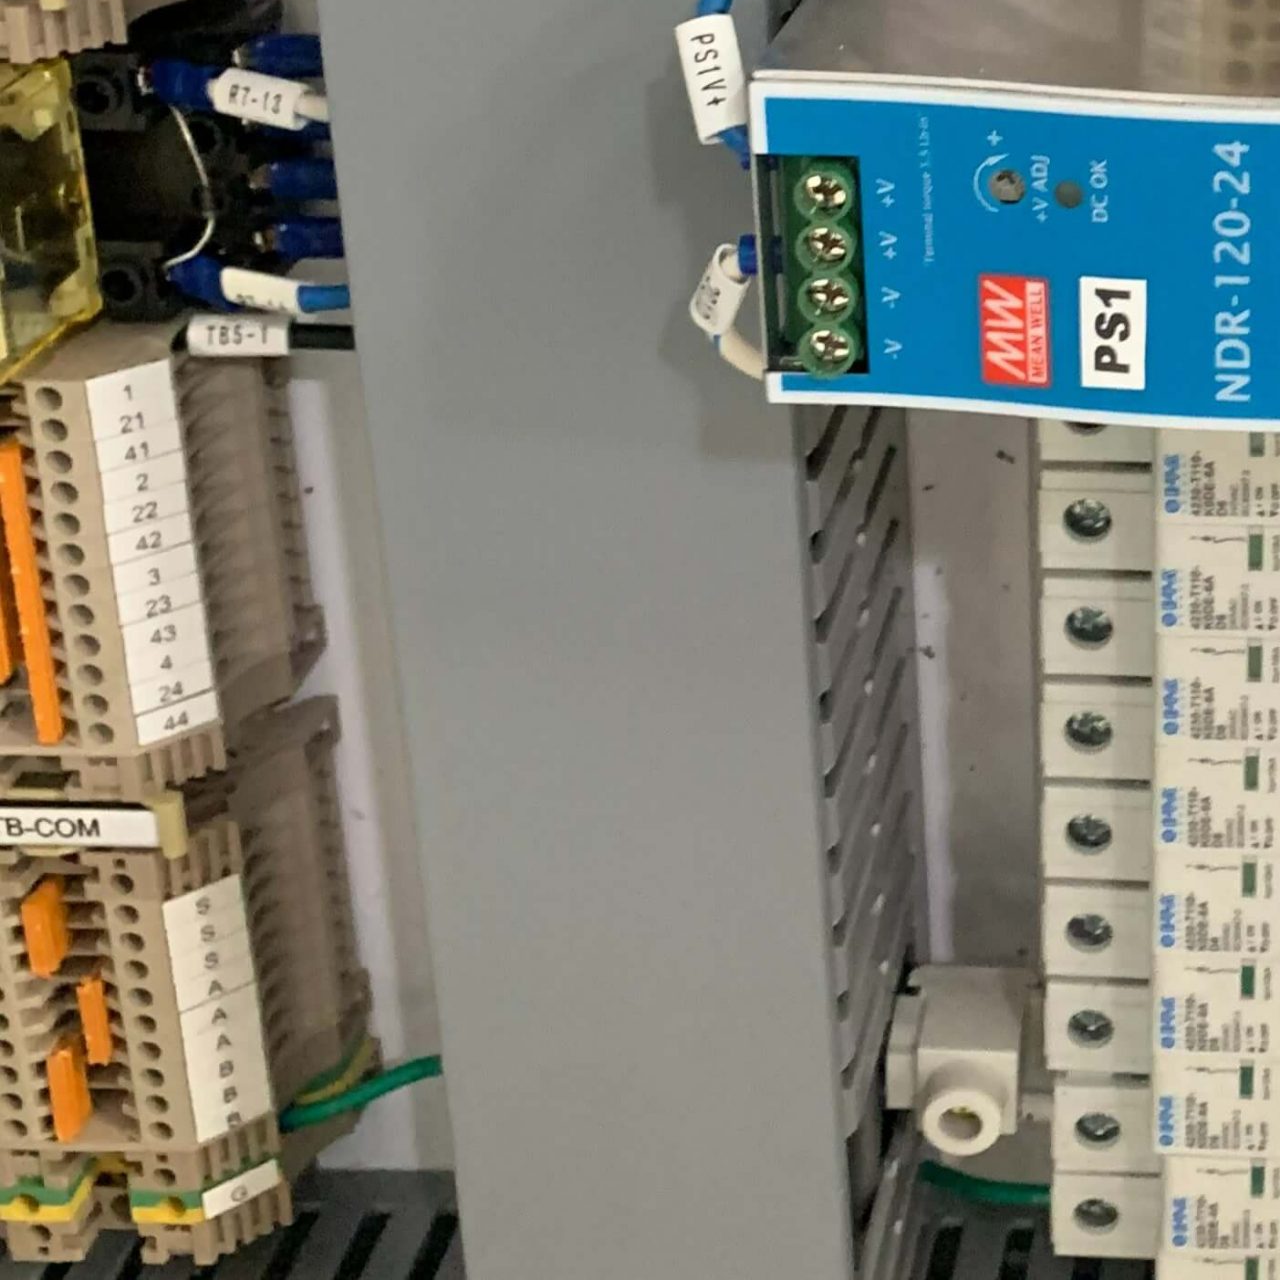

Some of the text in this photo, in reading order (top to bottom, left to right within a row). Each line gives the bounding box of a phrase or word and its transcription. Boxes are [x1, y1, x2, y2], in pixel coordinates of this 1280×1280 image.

[689, 32, 728, 107] PS1V+
[1030, 153, 1051, 193] ADJ
[876, 177, 896, 207] +V
[1089, 159, 1109, 224] DC OK
[879, 230, 899, 261] +V
[1212, 140, 1252, 403] NDR-120-24
[205, 321, 270, 345] TB5-1
[1029, 288, 1045, 378] MEAN WELL
[1094, 287, 1132, 374] PS1
[123, 384, 133, 402] 1
[119, 414, 144, 435] 21
[124, 441, 150, 461] 41
[135, 474, 150, 493] 2
[132, 500, 158, 523] 22
[135, 531, 162, 553] 42
[147, 567, 162, 586] 3
[146, 595, 172, 620] 23
[150, 625, 177, 644] 43
[160, 654, 173, 671] 4
[159, 679, 183, 702] 24
[163, 711, 189, 731] 44
[195, 897, 211, 915] S
[199, 924, 216, 942] S
[203, 951, 220, 969] S
[208, 980, 224, 997] A
[211, 1007, 228, 1024] A
[216, 1034, 232, 1049] A
[219, 1061, 235, 1078] B
[223, 1087, 238, 1104] B
